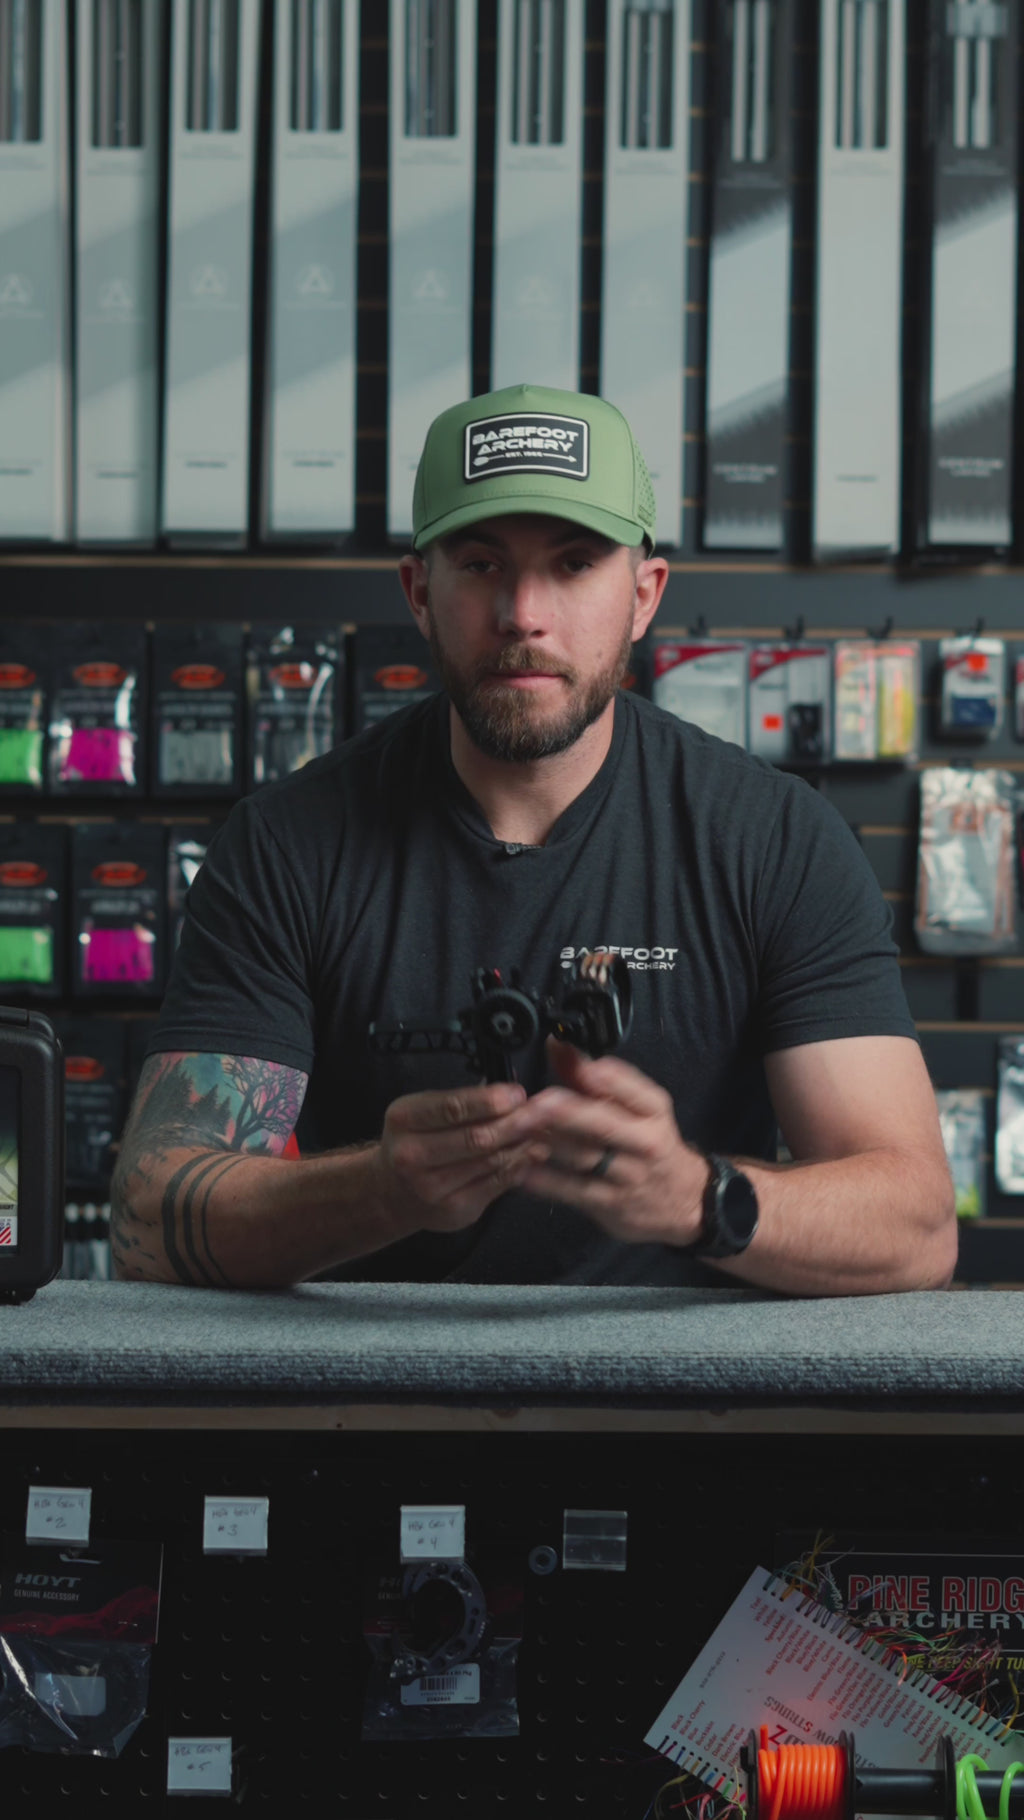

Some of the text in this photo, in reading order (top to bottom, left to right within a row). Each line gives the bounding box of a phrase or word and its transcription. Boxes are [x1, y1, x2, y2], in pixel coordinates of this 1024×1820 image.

[472, 426, 579, 445] BAREFOOT
[477, 438, 573, 455] ARCHERY
[627, 961, 676, 970] RCHERY
[15, 1573, 81, 1588] HOYT
[14, 1589, 80, 1601] GENUINE ACCESSORY
[848, 1574, 930, 1611] PINE
[764, 1658, 778, 1675] Black
[670, 1713, 684, 1730] Black
[678, 1698, 705, 1736] Black Cherry
[762, 1694, 814, 1733] STRINGS
[686, 1726, 699, 1741] Blue
[702, 1732, 718, 1752] Cedar
[710, 1722, 736, 1757] Dark Brown
[719, 1725, 745, 1762] Electric Blue
